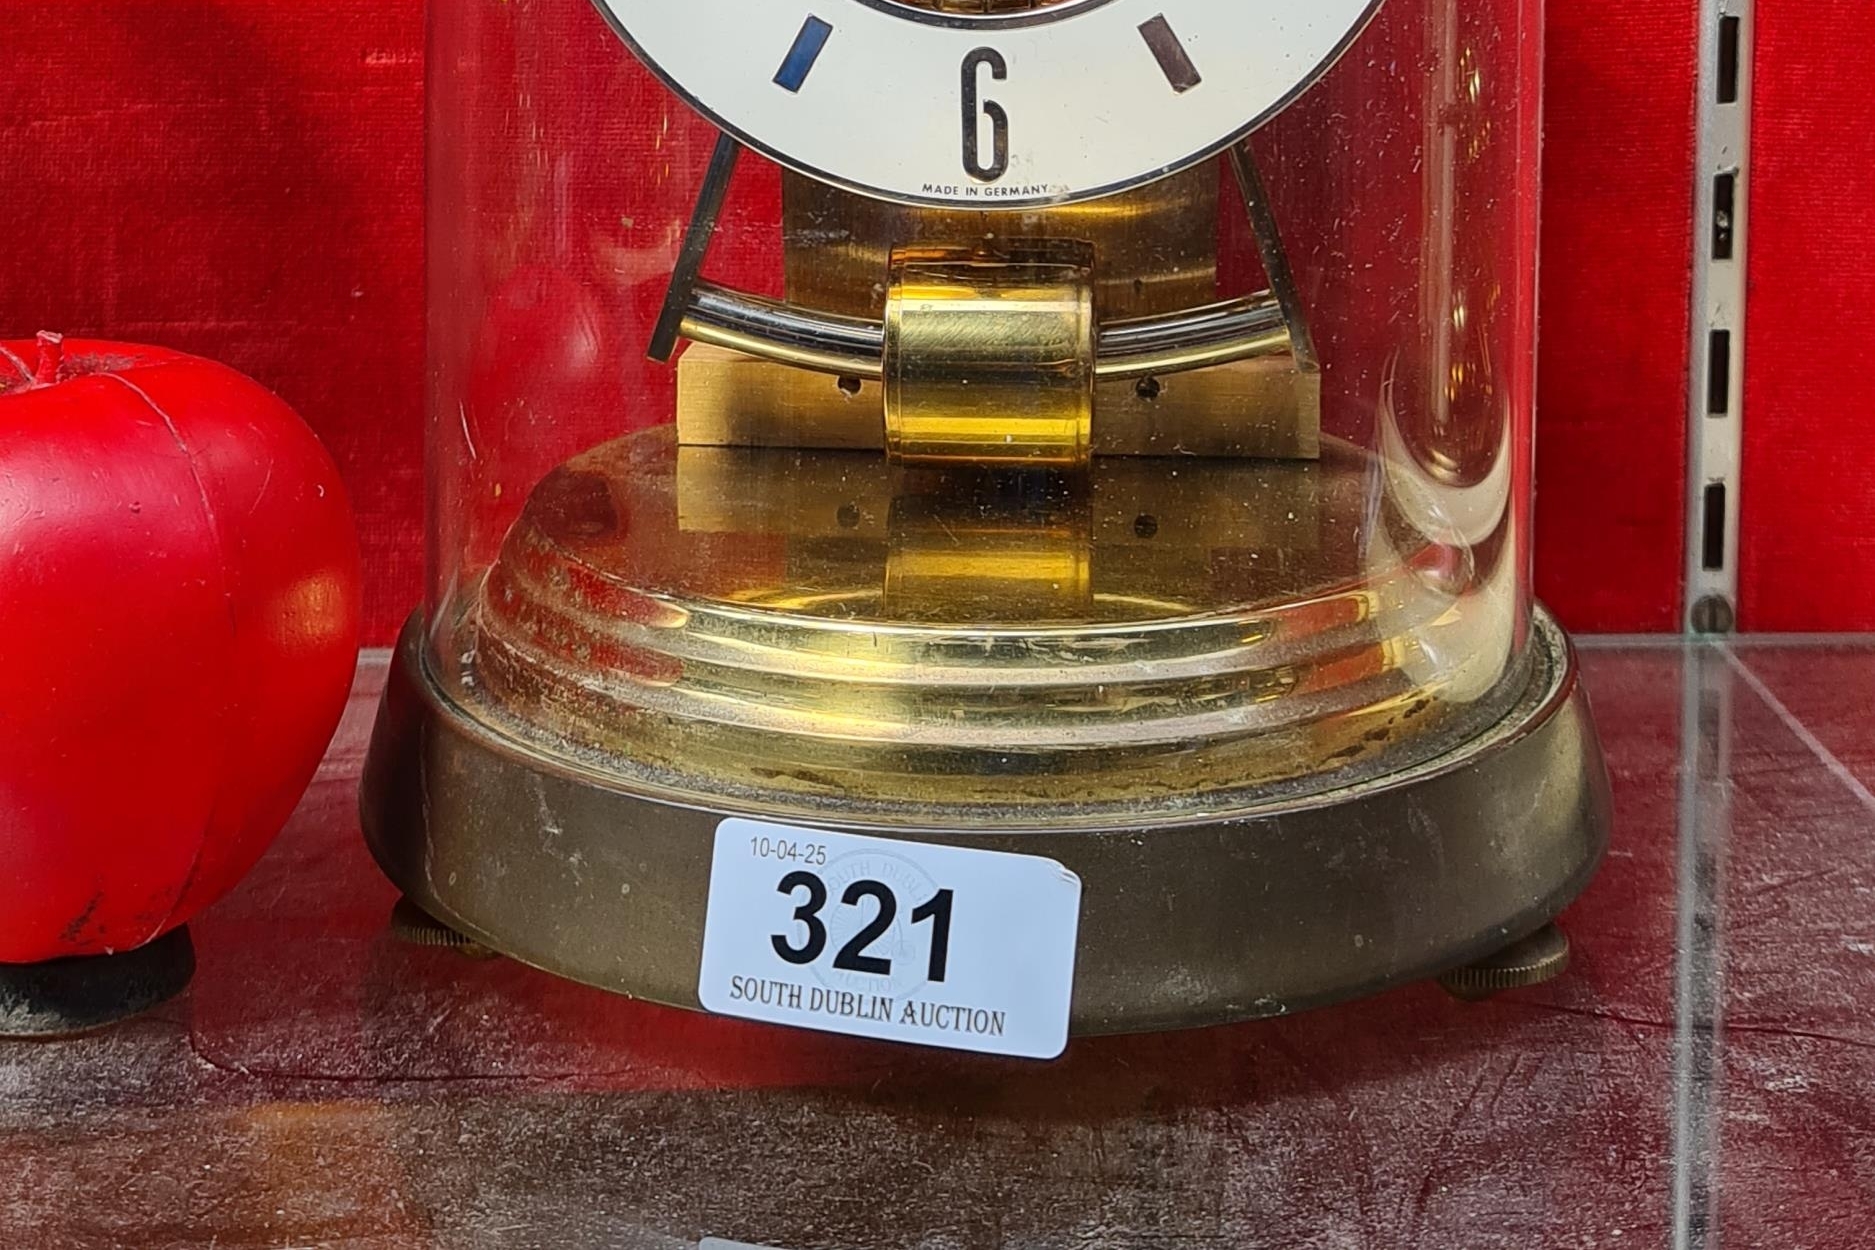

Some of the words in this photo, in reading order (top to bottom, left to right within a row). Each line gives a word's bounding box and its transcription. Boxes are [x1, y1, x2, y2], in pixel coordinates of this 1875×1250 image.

[960, 46, 1009, 183] 6
[921, 183, 959, 196] MADE
[965, 187, 979, 197] IN
[984, 184, 1049, 197] GERMANY
[750, 836, 826, 865] 10-04-25
[770, 870, 954, 983] 321
[729, 975, 803, 1010] SOUTH
[809, 987, 894, 1023] DUBLIN
[898, 1000, 1006, 1037] AUCTION
